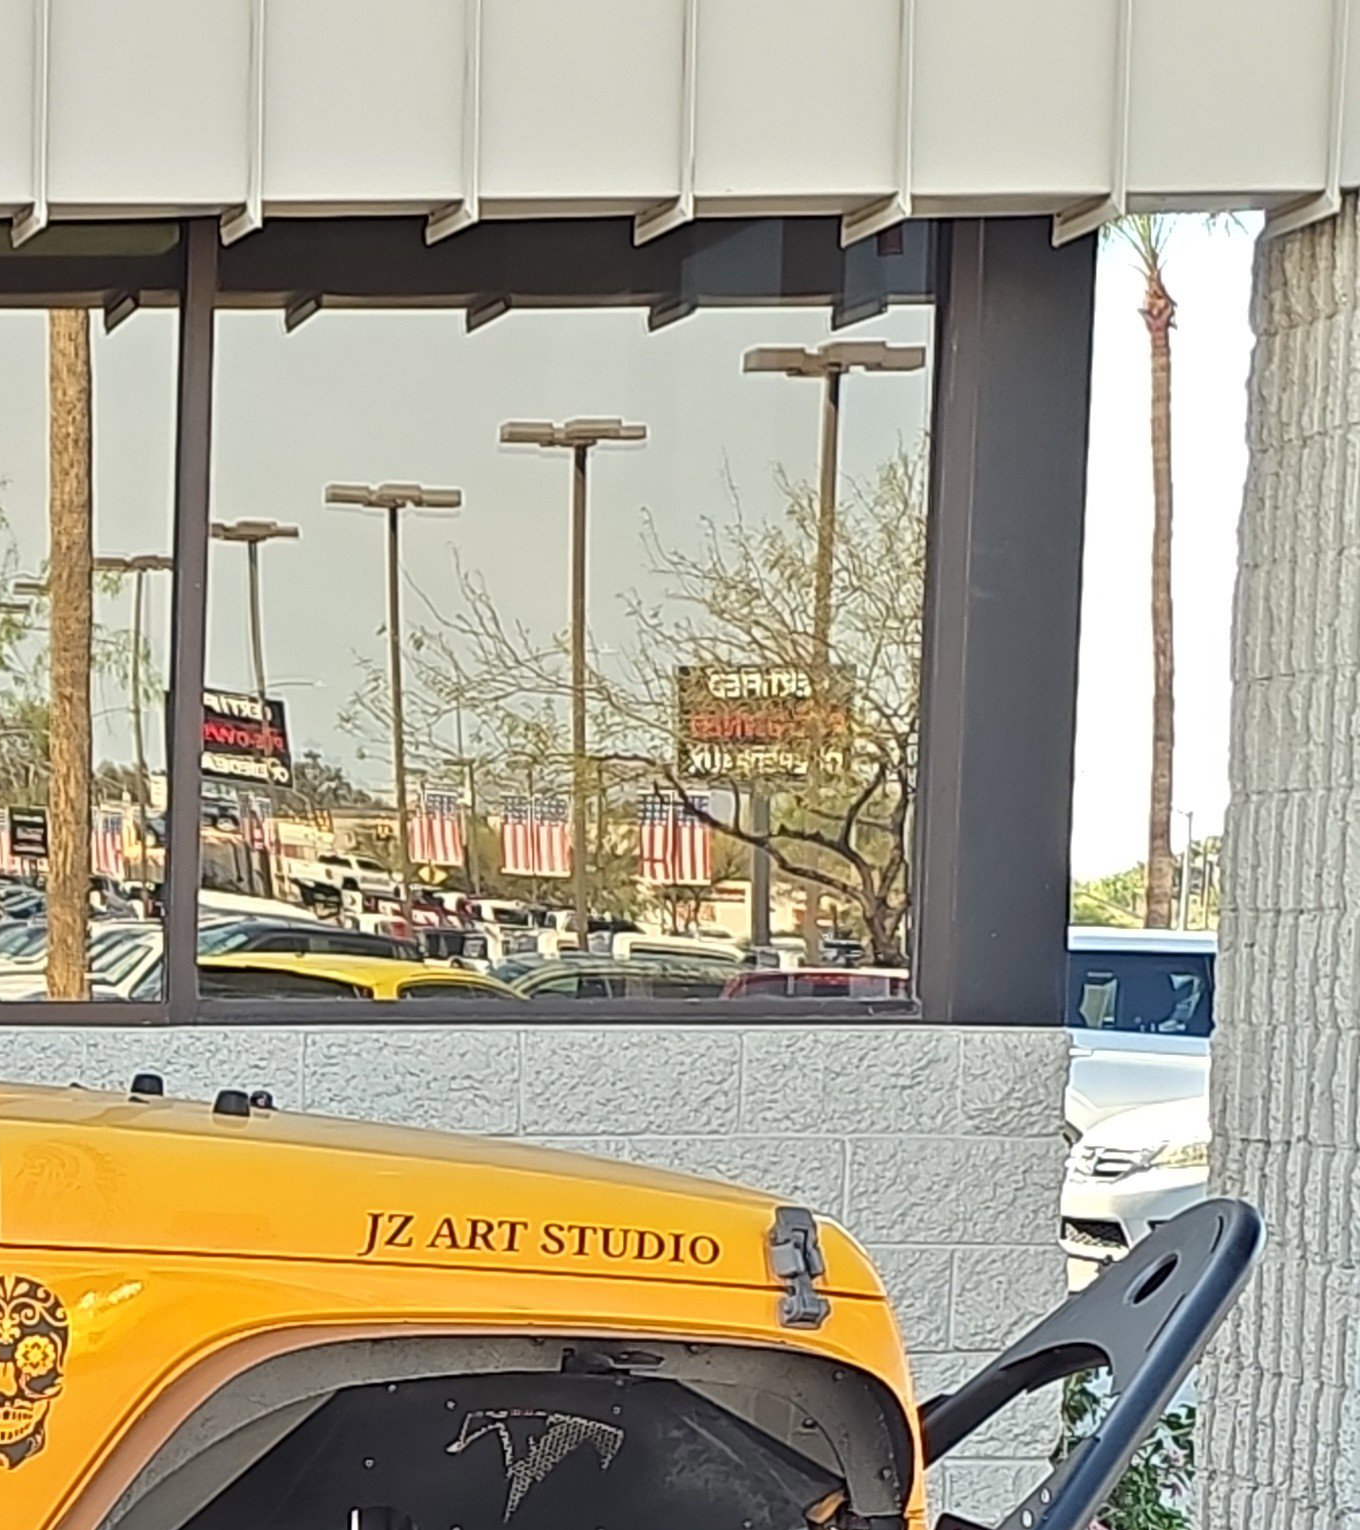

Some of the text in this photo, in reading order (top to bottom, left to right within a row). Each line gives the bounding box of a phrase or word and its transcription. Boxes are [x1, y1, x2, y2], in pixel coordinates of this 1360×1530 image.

[357, 1211, 721, 1265] JZ ART STUDIO
